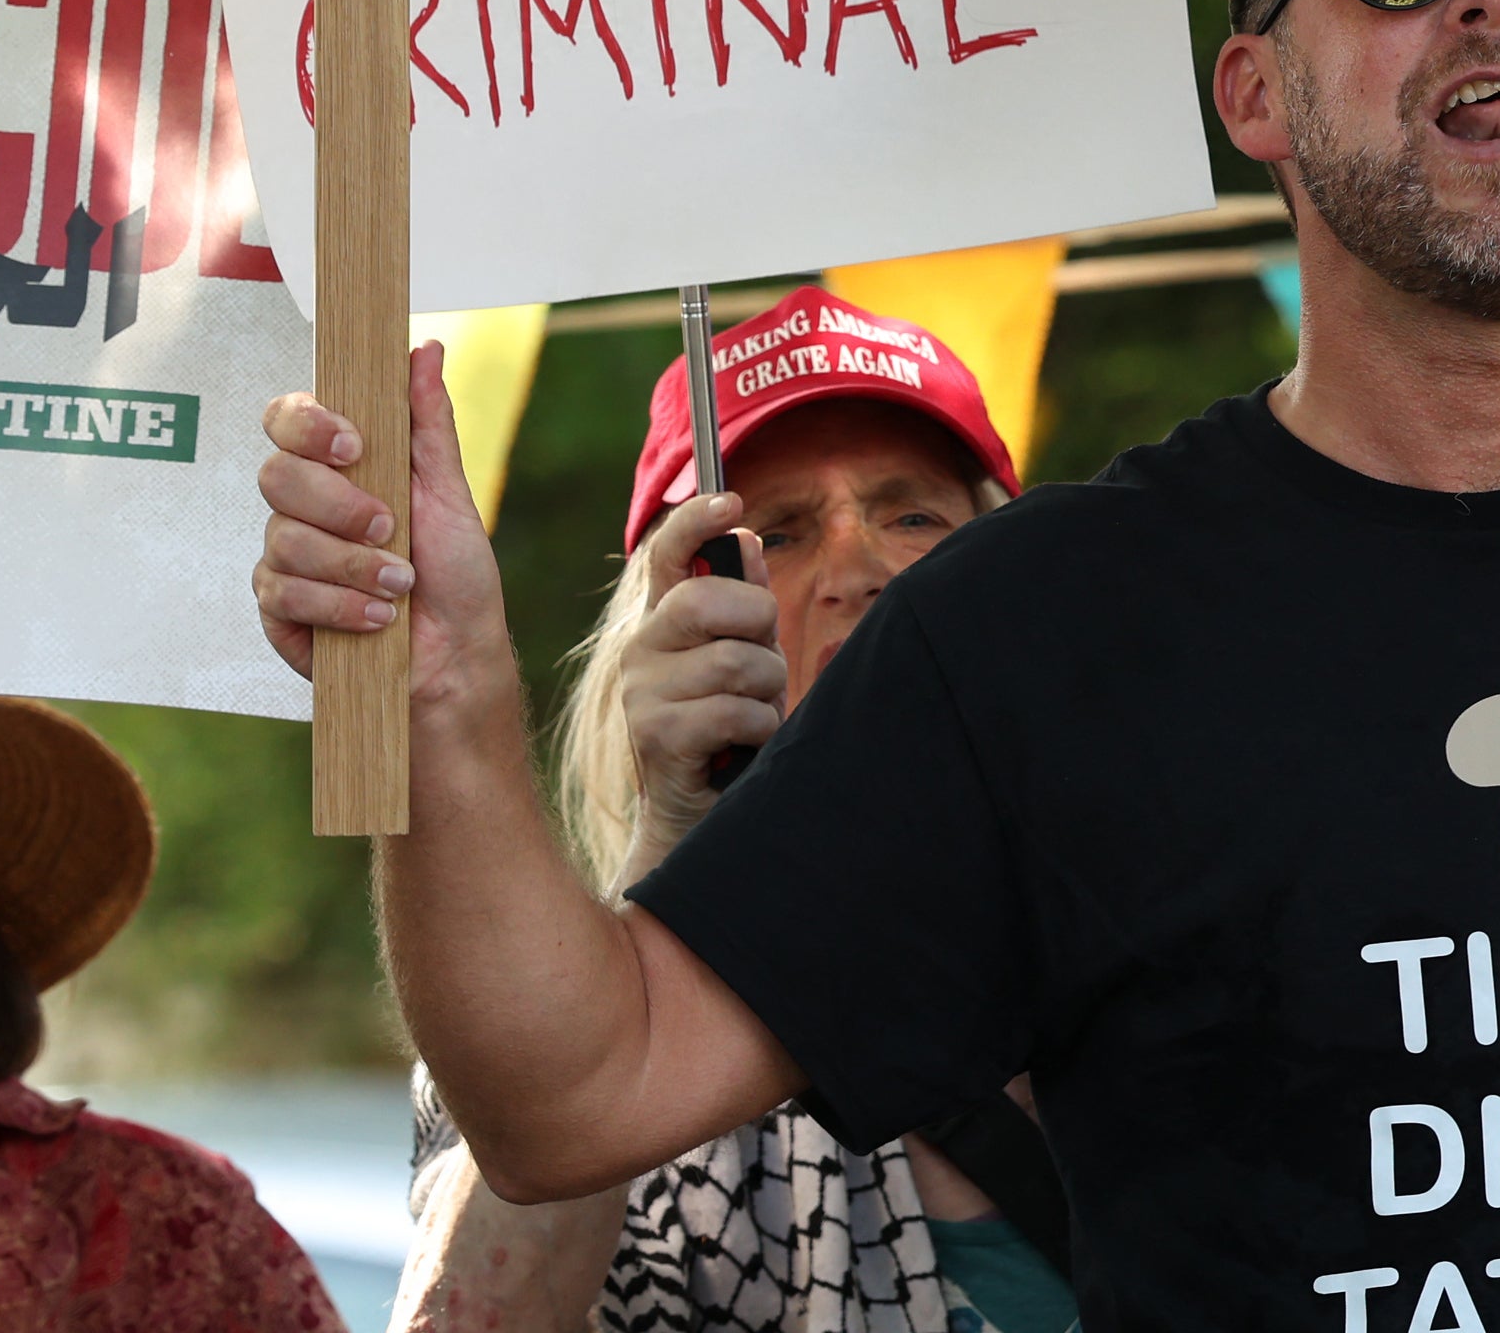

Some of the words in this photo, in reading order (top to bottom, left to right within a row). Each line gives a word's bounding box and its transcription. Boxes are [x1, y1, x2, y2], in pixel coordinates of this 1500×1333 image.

[712, 308, 812, 374] MAKING
[736, 343, 831, 397] GRATE
[836, 343, 923, 389] AGAIN
